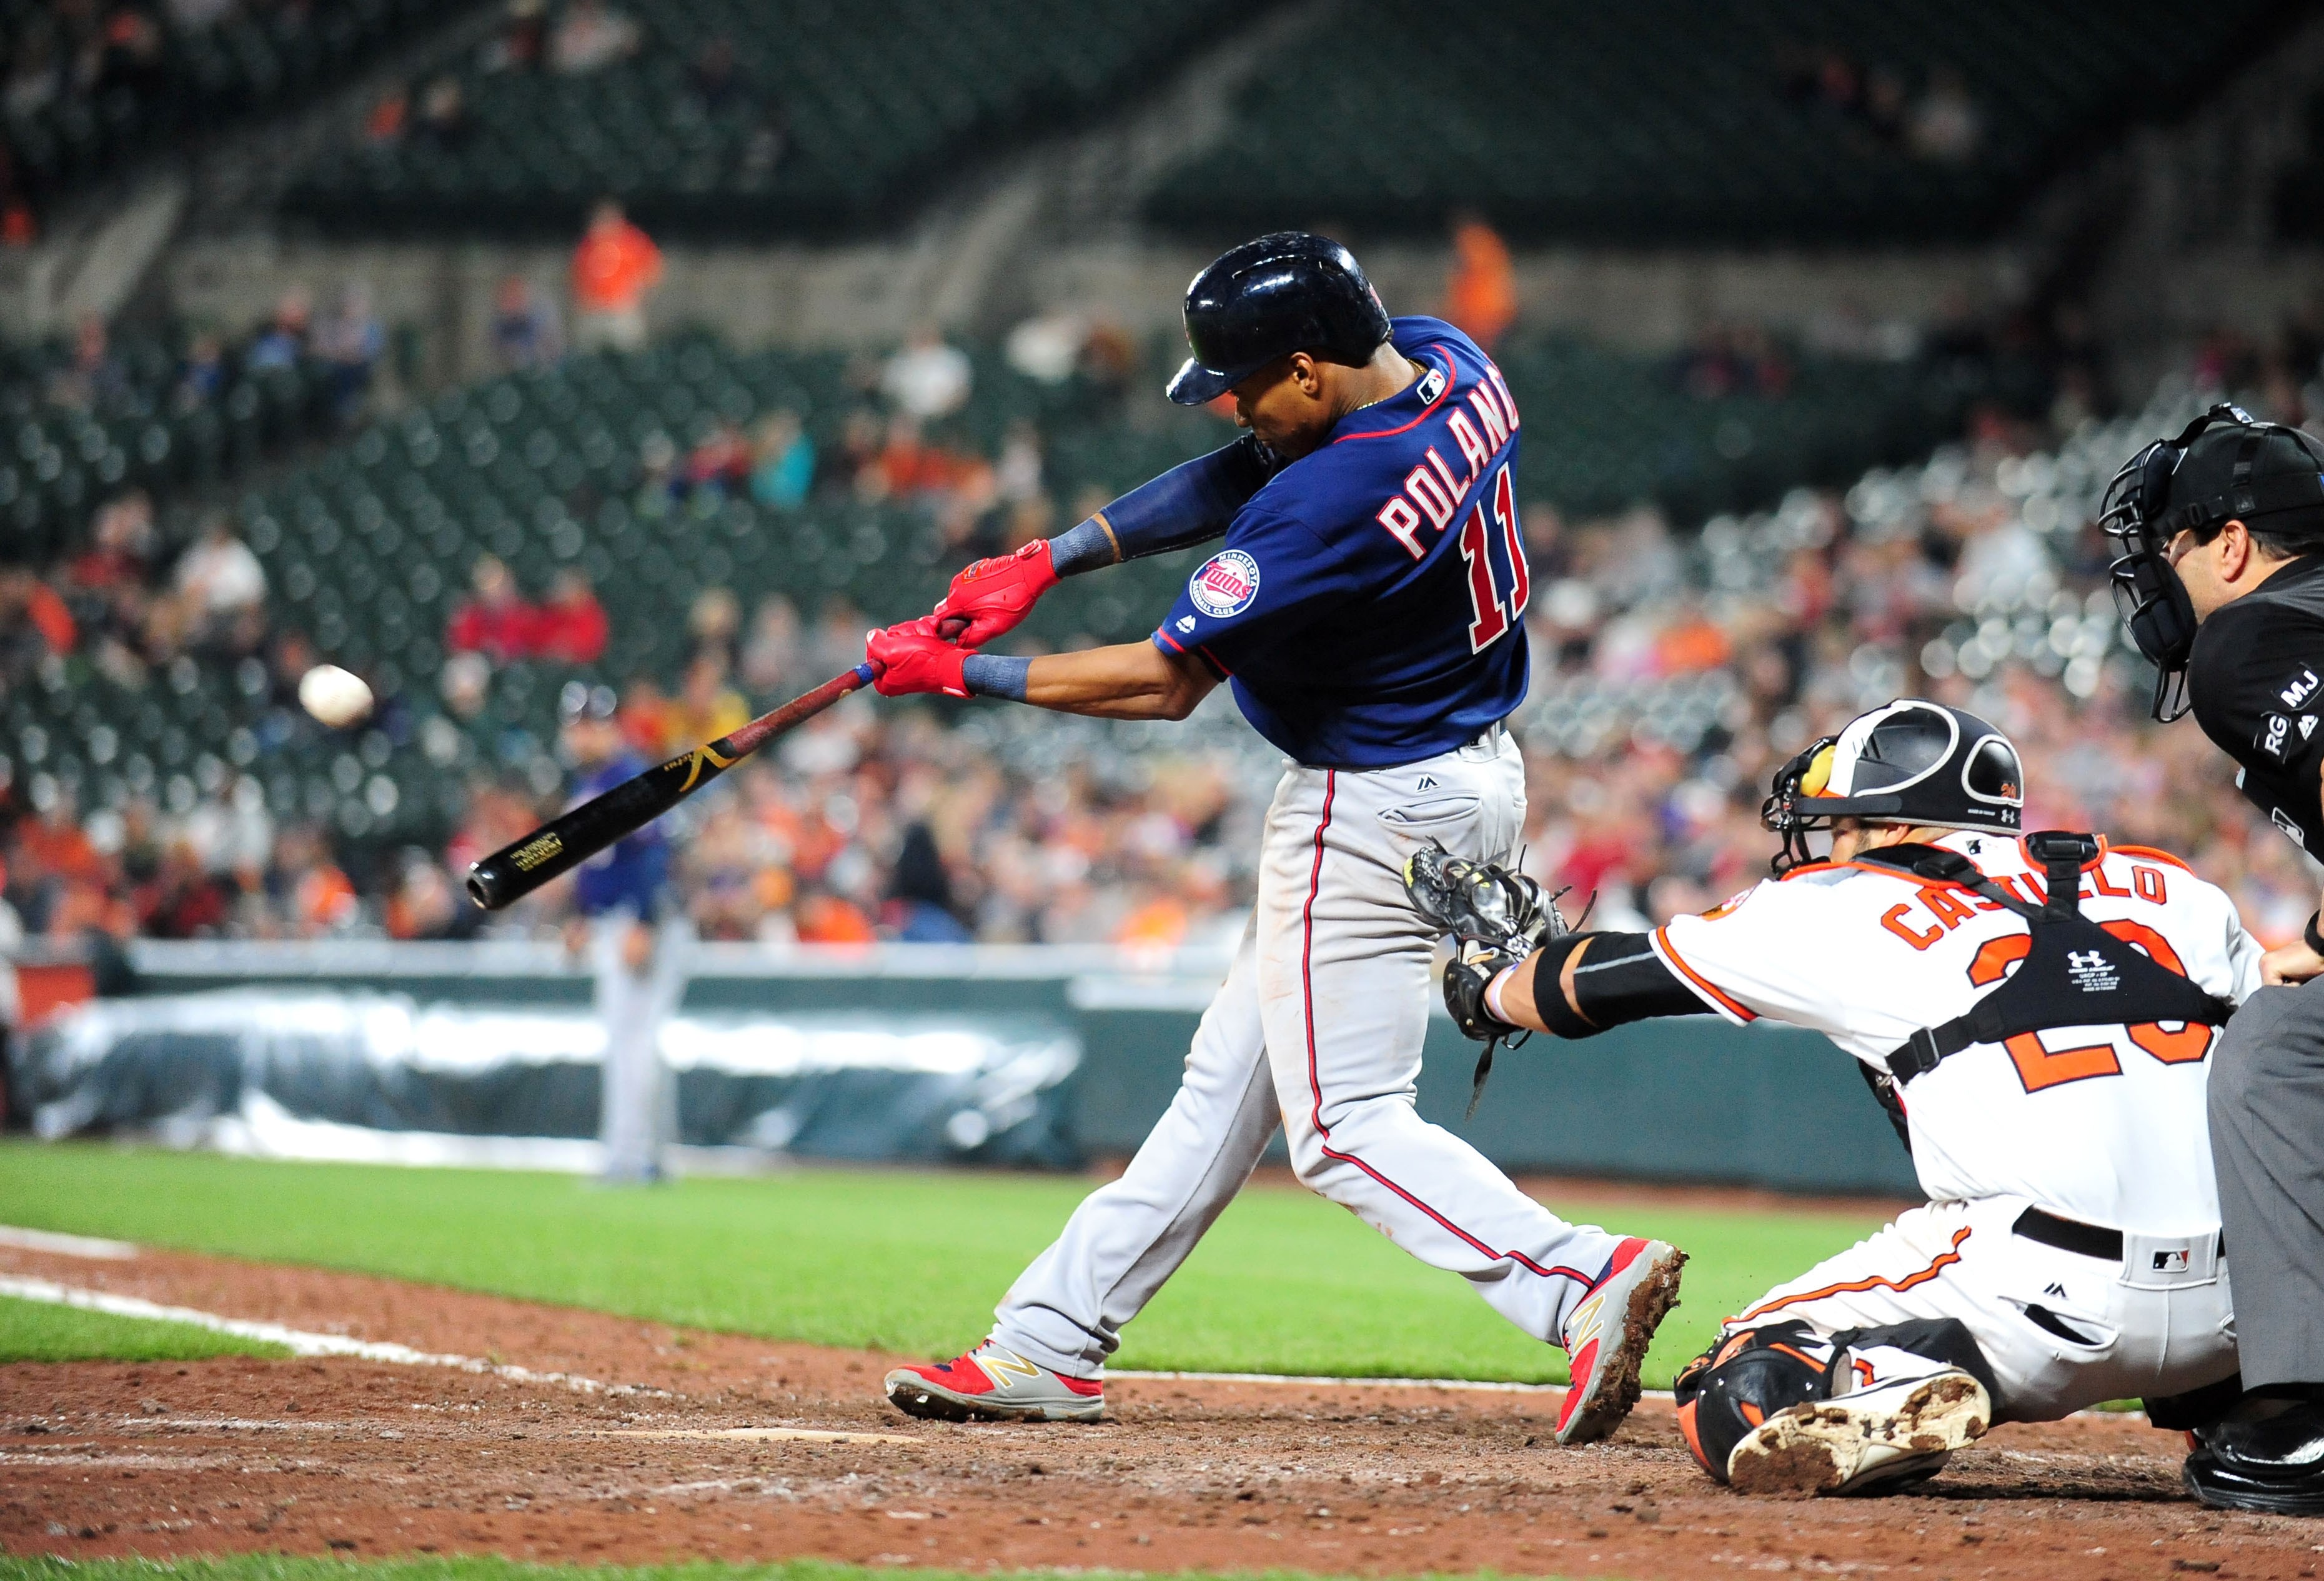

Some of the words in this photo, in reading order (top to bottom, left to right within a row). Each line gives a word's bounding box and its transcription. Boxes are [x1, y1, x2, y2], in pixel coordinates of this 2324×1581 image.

[1218, 553, 1257, 587] MINNESOTA
[1459, 461, 1529, 655] 11
[1193, 580, 1211, 612] BASEBALL
[1198, 561, 1253, 601] Twins
[2280, 670, 2319, 708] MJ
[2264, 715, 2288, 756] RG
[1880, 863, 2167, 951] CATILO
